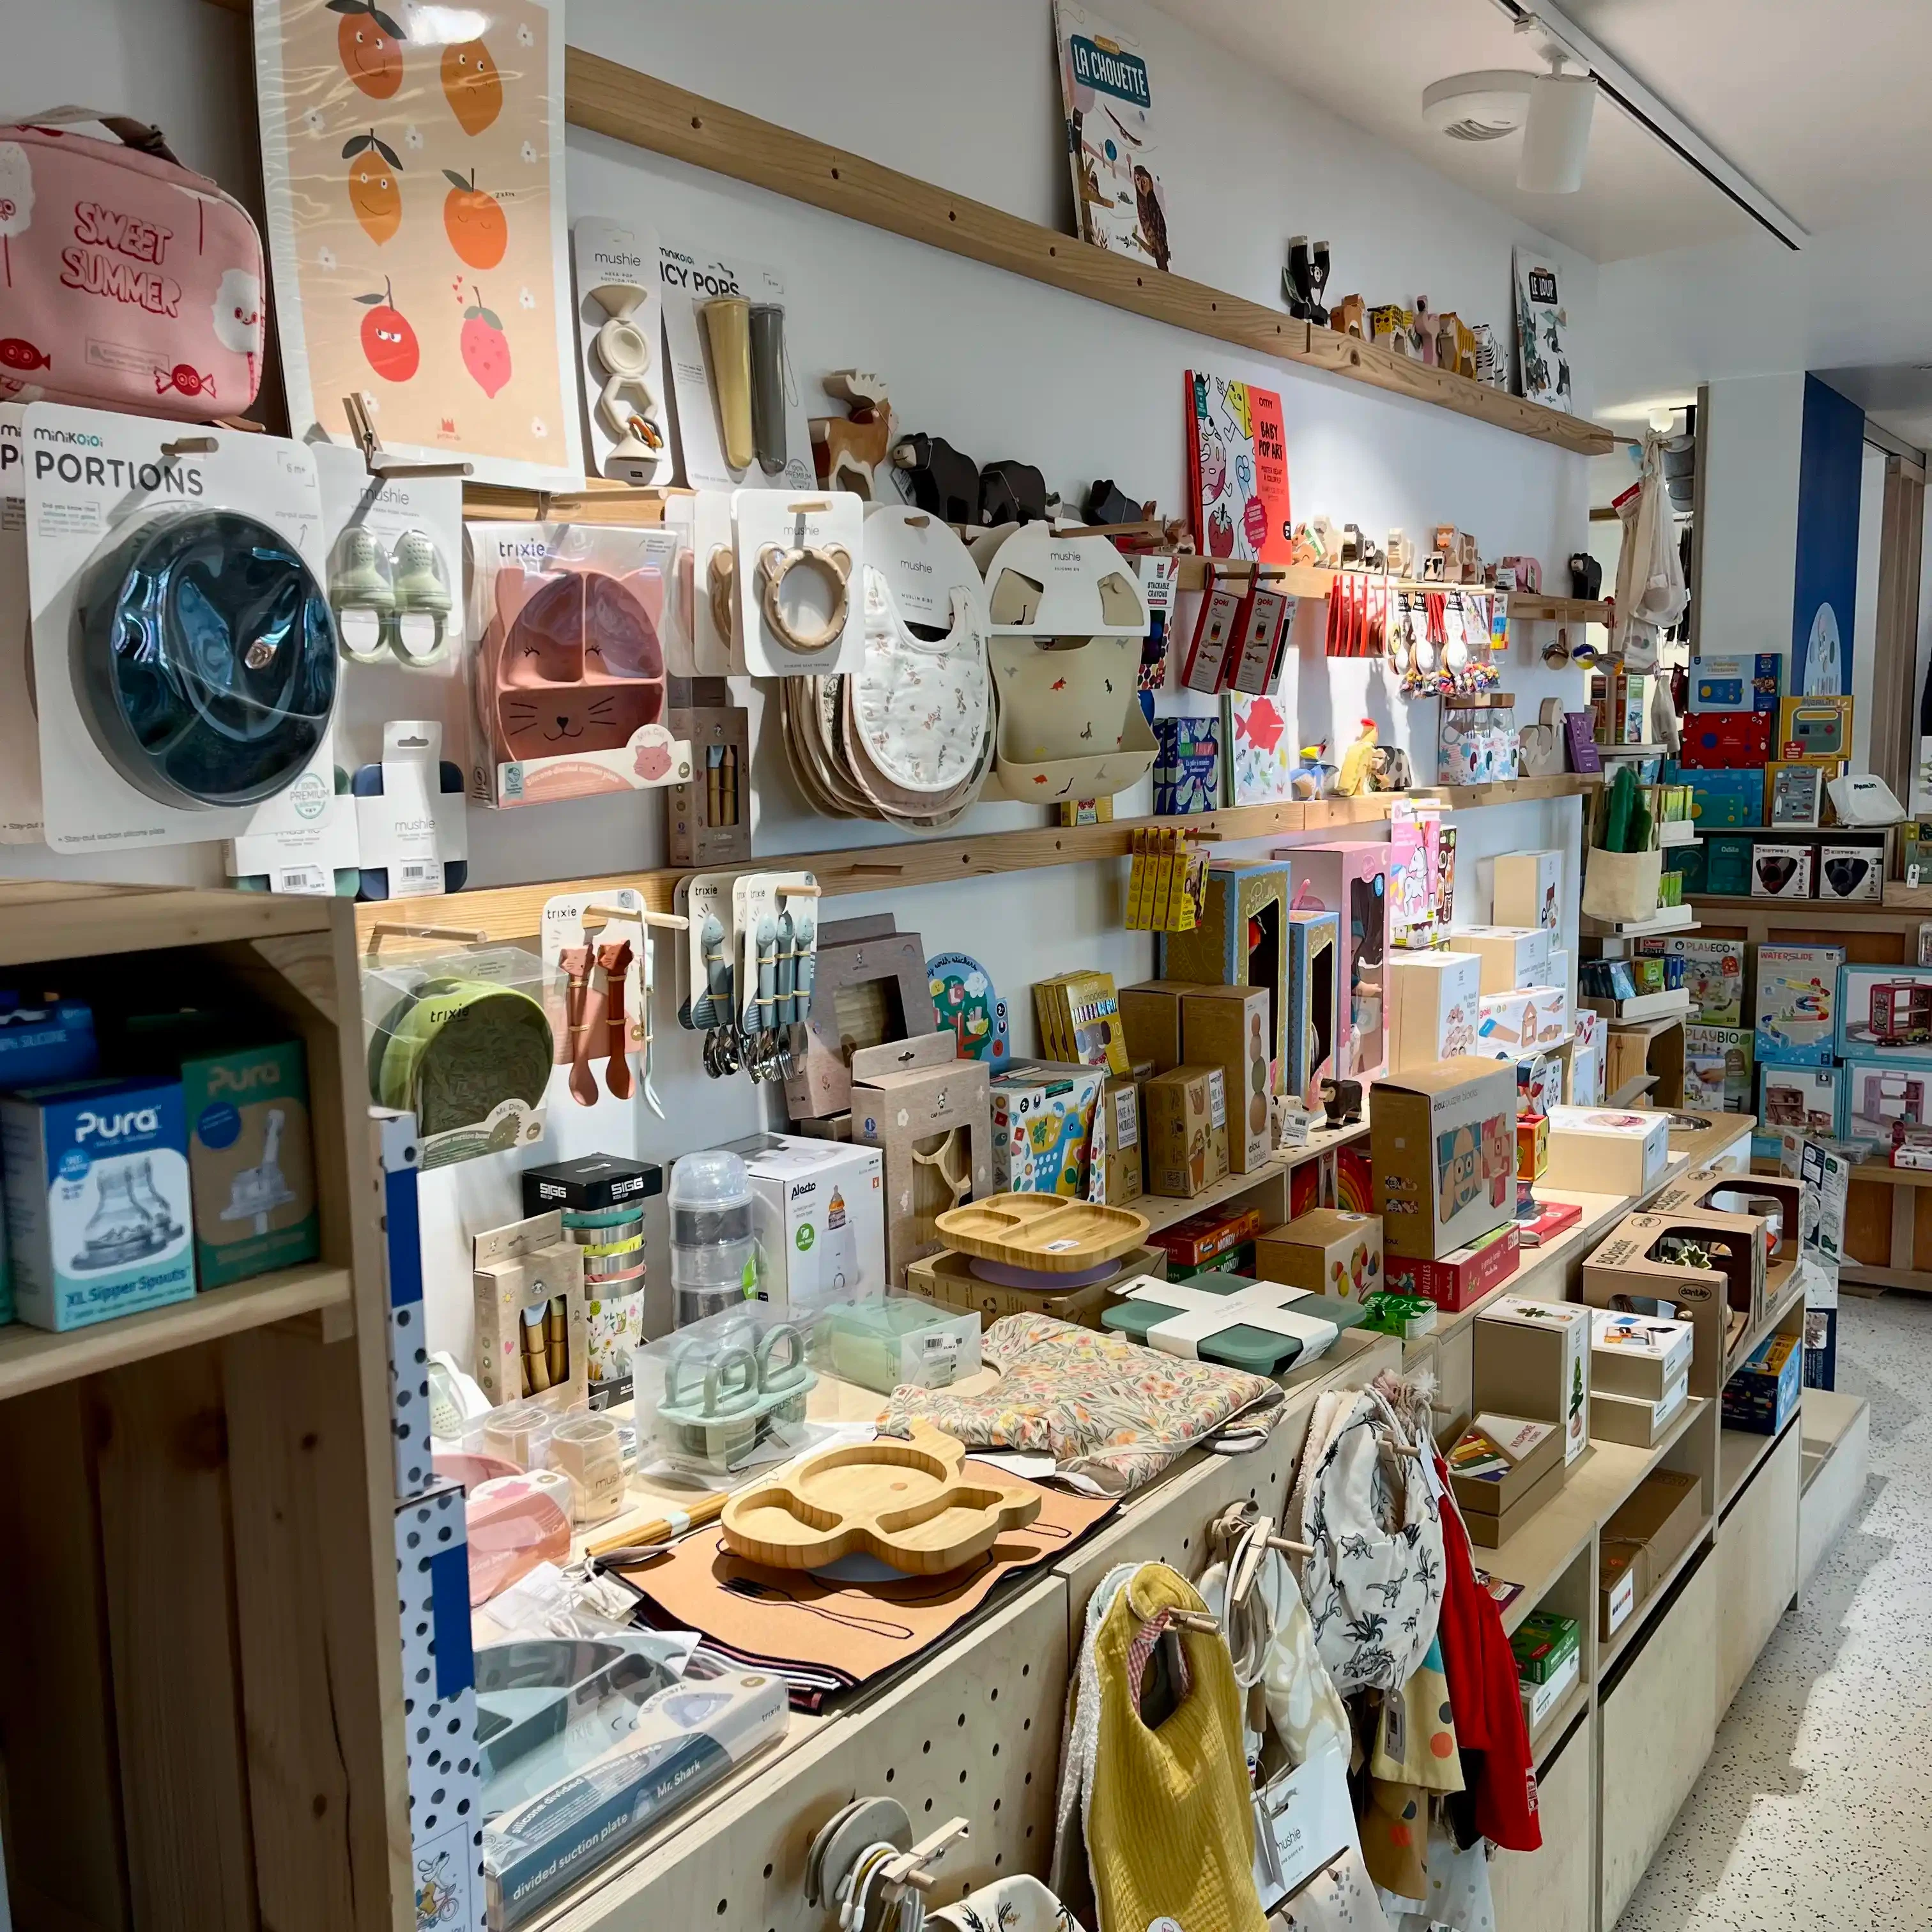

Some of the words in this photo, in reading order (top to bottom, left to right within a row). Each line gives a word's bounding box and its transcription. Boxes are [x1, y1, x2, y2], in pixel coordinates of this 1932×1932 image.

[1073, 43, 1090, 77] LA
[1091, 51, 1147, 96] CHOUETTE
[75, 201, 173, 264] SWEET
[595, 252, 641, 266] mushie
[61, 247, 181, 318] SUMMER
[659, 261, 687, 288] ICY
[693, 271, 739, 296] POPS
[34, 427, 103, 447] minikoioi
[1260, 420, 1278, 441] BABY
[1258, 439, 1270, 458] POP
[1271, 443, 1283, 461] ART
[35, 450, 203, 496] PORTIONS
[360, 487, 410, 505] mushie
[783, 525, 820, 536] mushie
[499, 537, 545, 557] trixie
[1050, 551, 1080, 562] mushie
[900, 559, 932, 574] mushie
[1147, 582, 1170, 590] STACKABLE
[1213, 597, 1229, 607] goki
[1257, 597, 1273, 606] goki
[290, 790, 330, 800] PREMIUM
[395, 817, 436, 831] mushie
[695, 884, 717, 896] trixie
[547, 905, 577, 919] trixie
[935, 956, 951, 969] with
[952, 956, 977, 970] stickers
[431, 1003, 469, 1022] trixie
[1685, 1029, 1739, 1043] PLAYBIO
[208, 1062, 280, 1096] Pura
[75, 1110, 158, 1142] Pura
[540, 1183, 567, 1199] SIGG
[611, 1177, 644, 1195] SIGG
[791, 1182, 816, 1200] Alecto
[1422, 1265, 1431, 1294] PUZZLES
[1681, 1286, 1708, 1298] dantoy
[769, 1390, 803, 1414] mushie
[595, 1466, 631, 1489] mushie
[762, 1703, 781, 1722] trixie
[512, 1802, 544, 1835] silicone
[544, 1775, 583, 1807] divided
[584, 1756, 629, 1781] suction
[629, 1742, 662, 1762] plate
[656, 1780, 673, 1799] Mr.
[674, 1759, 702, 1788] Shark
[513, 1862, 558, 1901] divided
[558, 1830, 599, 1869] suction
[601, 1812, 628, 1841] plate
